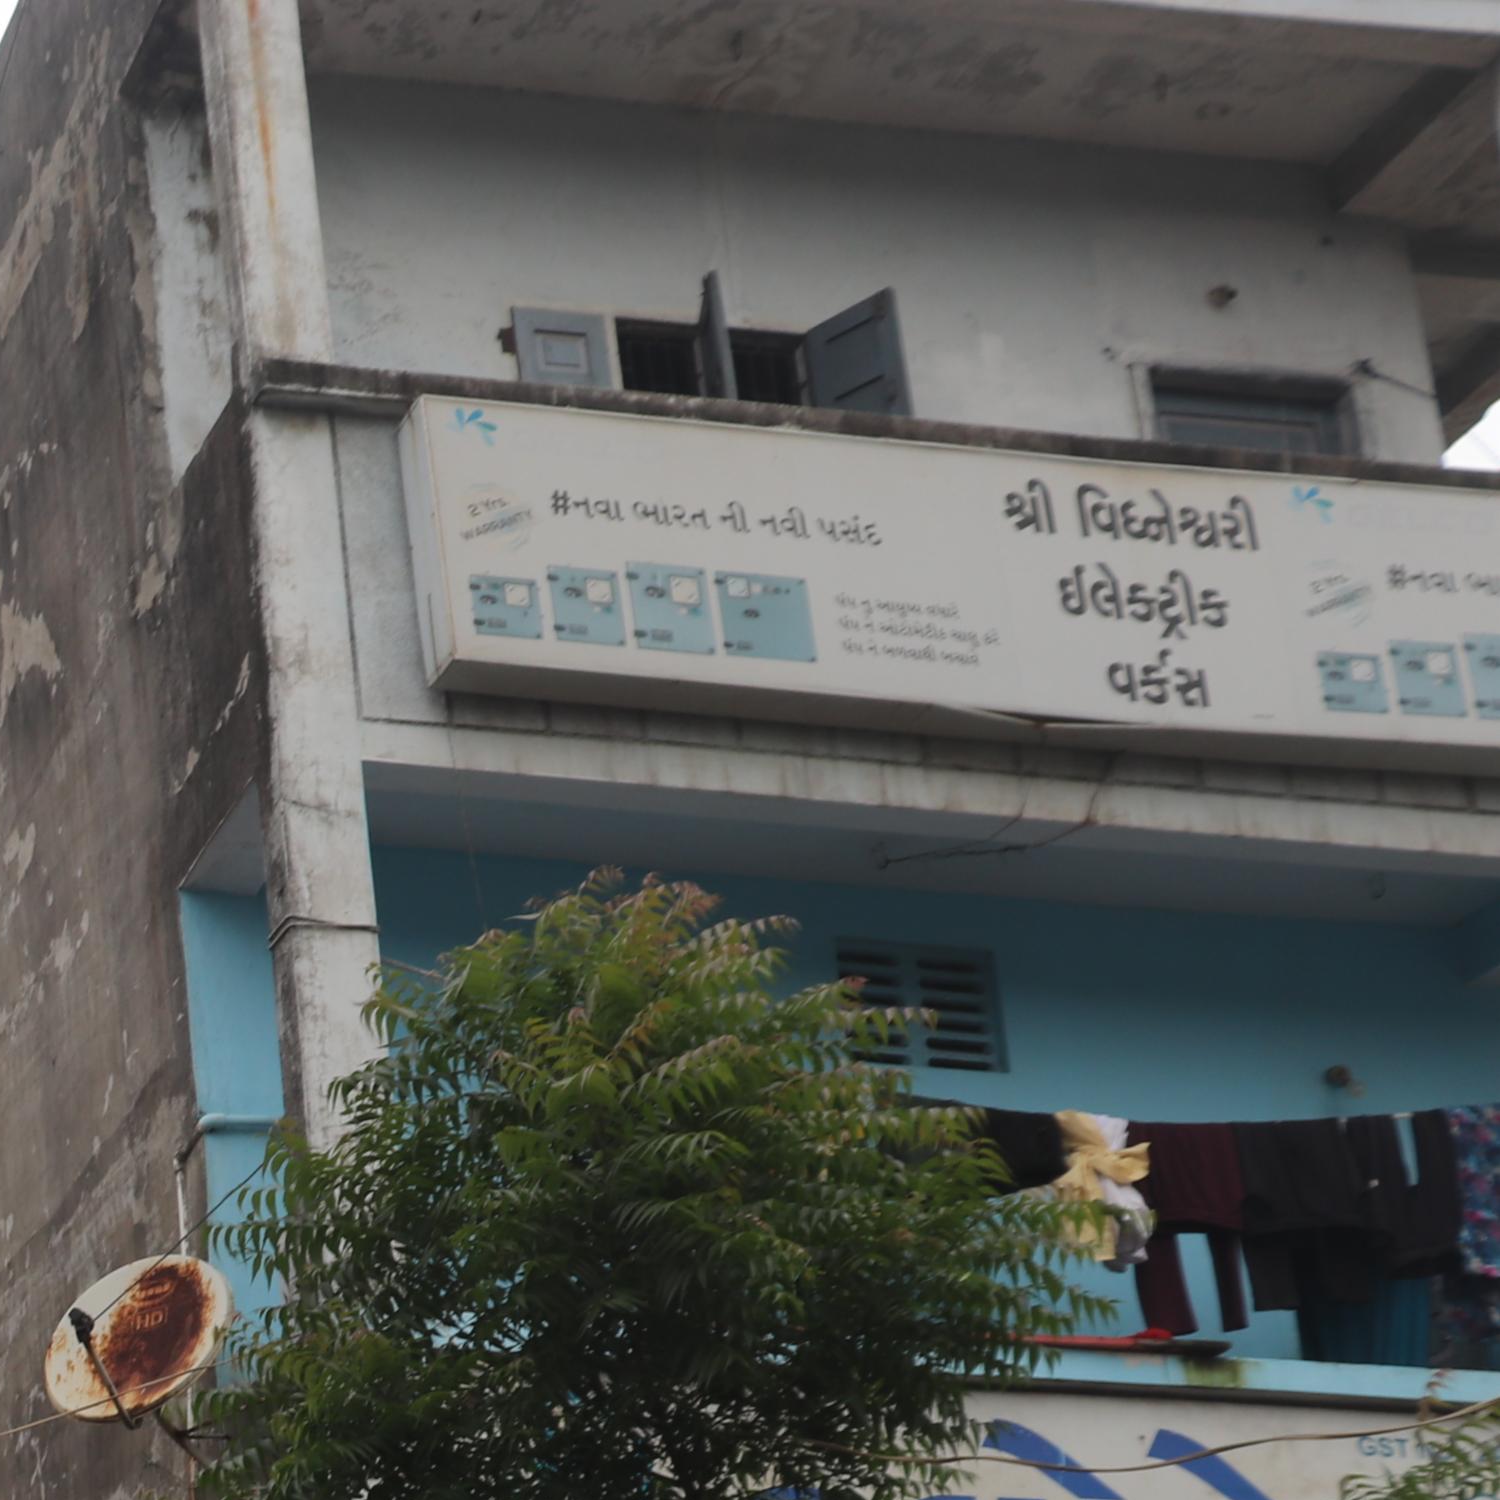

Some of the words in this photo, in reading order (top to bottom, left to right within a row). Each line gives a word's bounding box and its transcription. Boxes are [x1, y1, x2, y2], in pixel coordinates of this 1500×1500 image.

[633, 501, 711, 530] ભારત
[760, 510, 811, 539] નવી
[816, 515, 883, 546] પસંદ
[1005, 479, 1057, 534] શ્રી
[1357, 1435, 1408, 1457] GST
